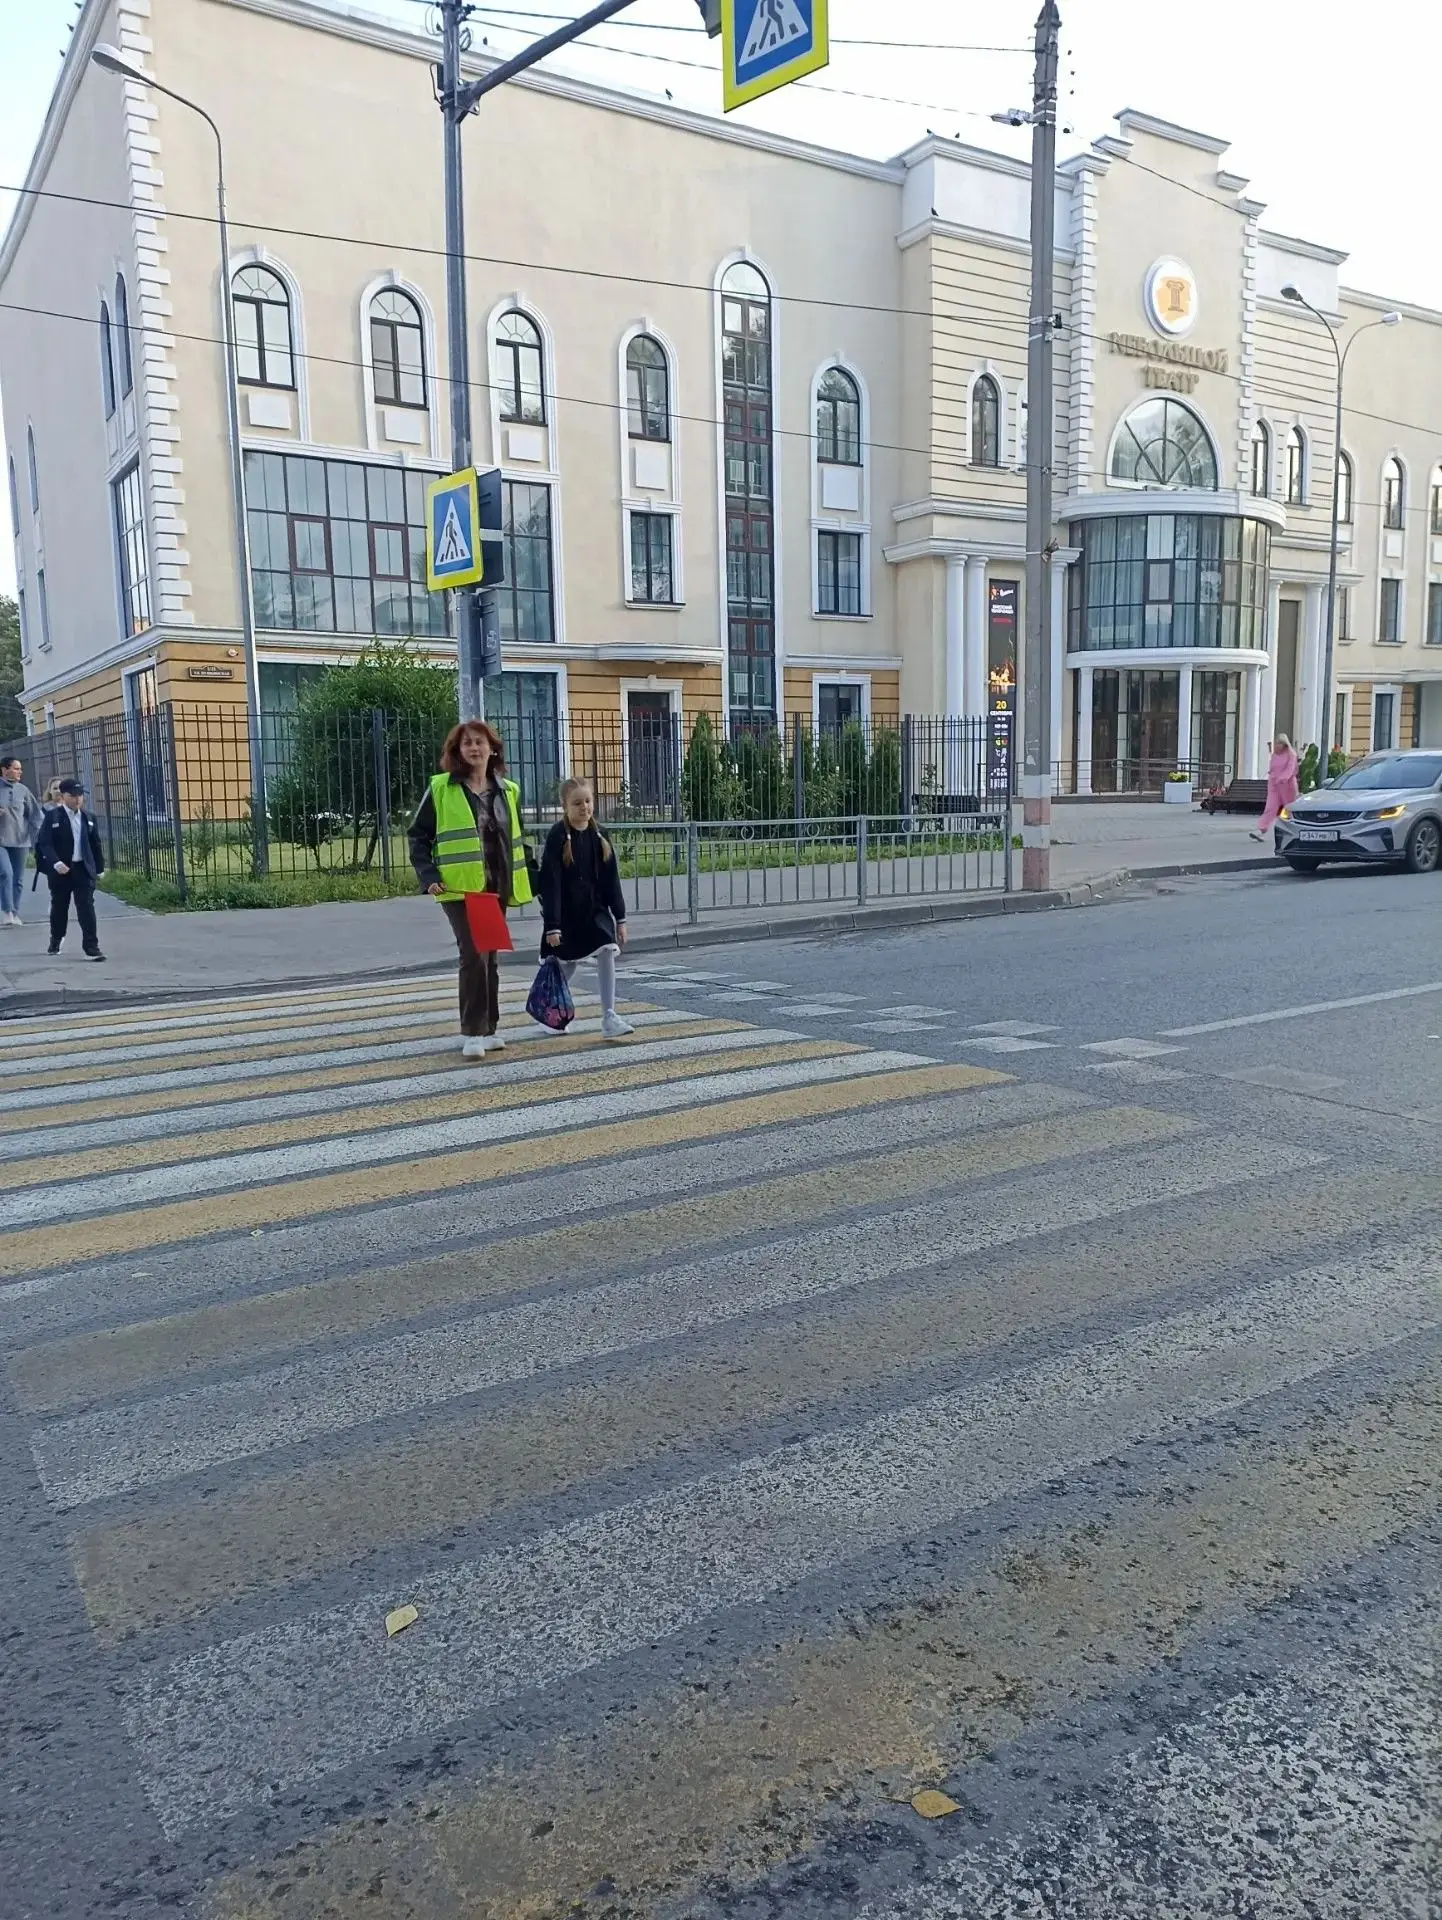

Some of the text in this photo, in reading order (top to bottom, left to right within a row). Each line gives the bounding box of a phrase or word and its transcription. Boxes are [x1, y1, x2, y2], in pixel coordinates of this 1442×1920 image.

[1109, 332, 1229, 373] НЕБОЛЬШОЙ
[1141, 364, 1200, 394] ТЕАТР
[995, 700, 1007, 710] 20
